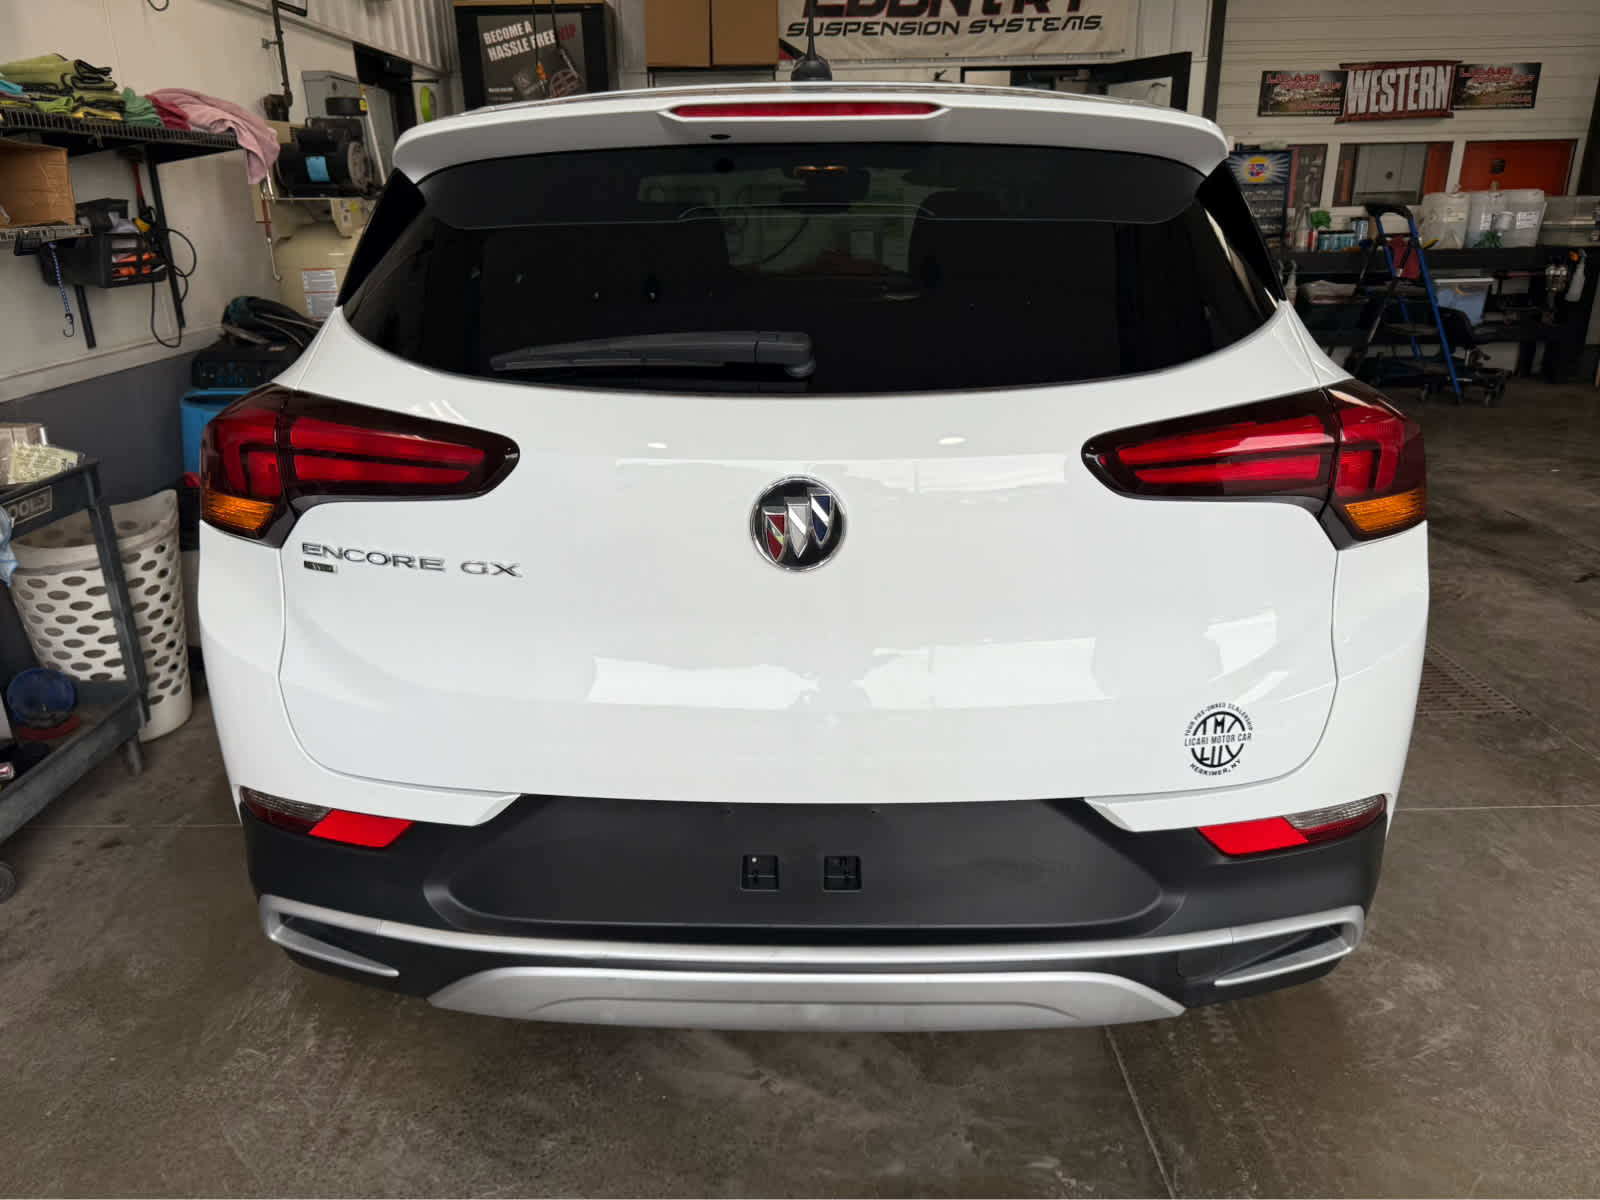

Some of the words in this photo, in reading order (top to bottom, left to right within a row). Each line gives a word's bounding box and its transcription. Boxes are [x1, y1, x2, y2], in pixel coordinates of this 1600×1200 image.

[482, 23, 525, 45] BECOME
[523, 20, 533, 33] A
[786, 20, 961, 37] SUSPENSION
[967, 15, 1103, 34] SYSTEMS
[487, 37, 531, 62] HASSLE
[529, 29, 557, 49] FREE
[1346, 65, 1452, 114] WESTERN
[301, 541, 447, 572] ENCORE
[459, 559, 523, 578] GX
[1184, 736, 1209, 747] LICARI
[1210, 734, 1236, 744] MOTOR
[1237, 732, 1252, 742] CAR
